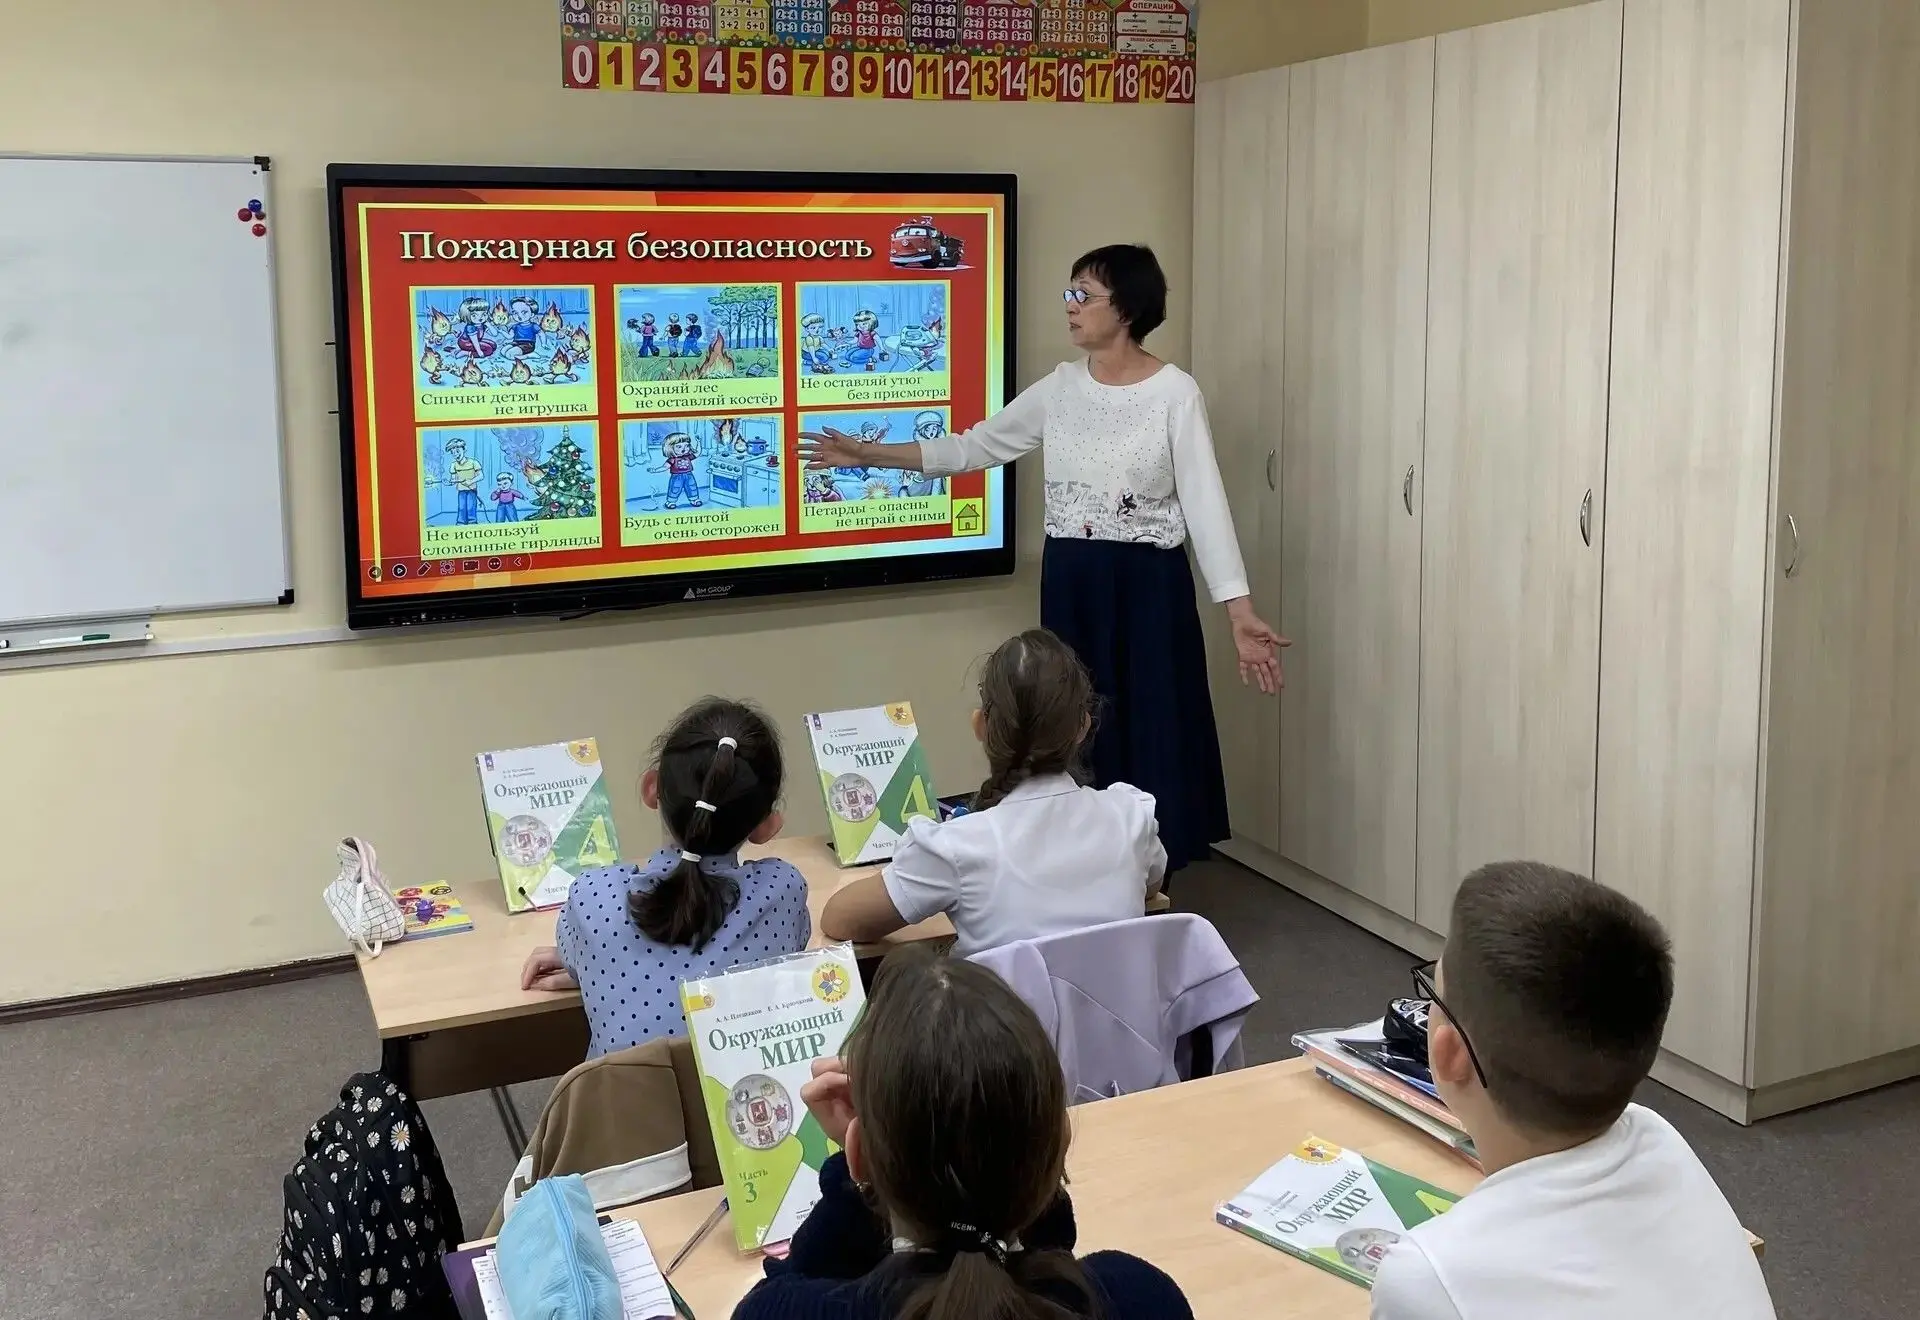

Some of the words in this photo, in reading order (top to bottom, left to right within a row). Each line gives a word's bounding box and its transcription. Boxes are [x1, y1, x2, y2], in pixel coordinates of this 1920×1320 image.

[630, 3, 649, 12] 2+1
[688, 6, 707, 16] 3+1
[720, 8, 739, 17] 2+3
[746, 9, 764, 18] 4+1
[568, 13, 588, 23] 0+1
[599, 15, 619, 24] 2+0
[630, 16, 650, 25] 3+0
[688, 18, 707, 28] 4+0
[720, 21, 739, 30] 3+2
[746, 22, 765, 30] 5+0
[571, 45, 593, 84] 0
[606, 46, 623, 85] 1
[639, 48, 661, 86] 2
[672, 48, 693, 88] 3
[704, 51, 725, 88] 4
[736, 51, 757, 90] 5
[766, 53, 787, 91] 6
[799, 54, 820, 91] 7
[831, 55, 849, 92] 8
[858, 55, 879, 94] 9
[885, 58, 912, 95] 10
[915, 59, 939, 95] 11
[944, 60, 970, 95] 12
[971, 61, 999, 97] 13
[1001, 61, 1027, 96] 14
[1029, 62, 1057, 97] 15
[1057, 62, 1084, 97] 16
[1085, 63, 1113, 97] 17
[1114, 63, 1139, 98] 18
[1141, 64, 1166, 99] 19
[1167, 65, 1195, 99] 20
[399, 231, 616, 267] Пожарная
[626, 231, 874, 260] безопасность
[622, 382, 690, 398] Охраняй
[693, 384, 719, 394] лес
[800, 378, 820, 389] Не
[823, 375, 887, 388] оставляй
[890, 376, 923, 388] утюг
[421, 393, 486, 407] Спички
[490, 392, 539, 405] детям
[635, 399, 653, 409] не
[657, 394, 726, 408] оставляй
[729, 393, 778, 406] костёр
[847, 389, 870, 401] без
[873, 388, 947, 401] присмотра
[494, 405, 514, 415] не
[518, 403, 588, 417] игрушка
[804, 506, 866, 518] Петарды
[878, 501, 929, 513] опасны
[624, 517, 660, 530] Будь
[663, 517, 672, 526] с
[675, 511, 730, 525] плитой
[835, 518, 852, 528] не
[856, 512, 896, 527] играй
[899, 514, 906, 523] с
[909, 511, 946, 522] ними
[426, 530, 449, 542] Не
[454, 524, 540, 540] используй
[654, 528, 698, 540] очень
[701, 523, 780, 537] осторожен
[422, 542, 517, 557] сломанные
[520, 535, 601, 551] гирлянды
[707, 585, 731, 593] GROUP
[822, 736, 906, 756] Окружающий
[854, 750, 895, 768] МИР
[493, 775, 589, 797] Окружающий
[529, 789, 575, 810] МИР
[708, 1006, 845, 1051] Окружающий
[759, 1032, 826, 1070] МИР
[738, 1169, 769, 1180] Часть
[743, 1181, 758, 1204] 3
[1324, 1187, 1374, 1225] МИР
